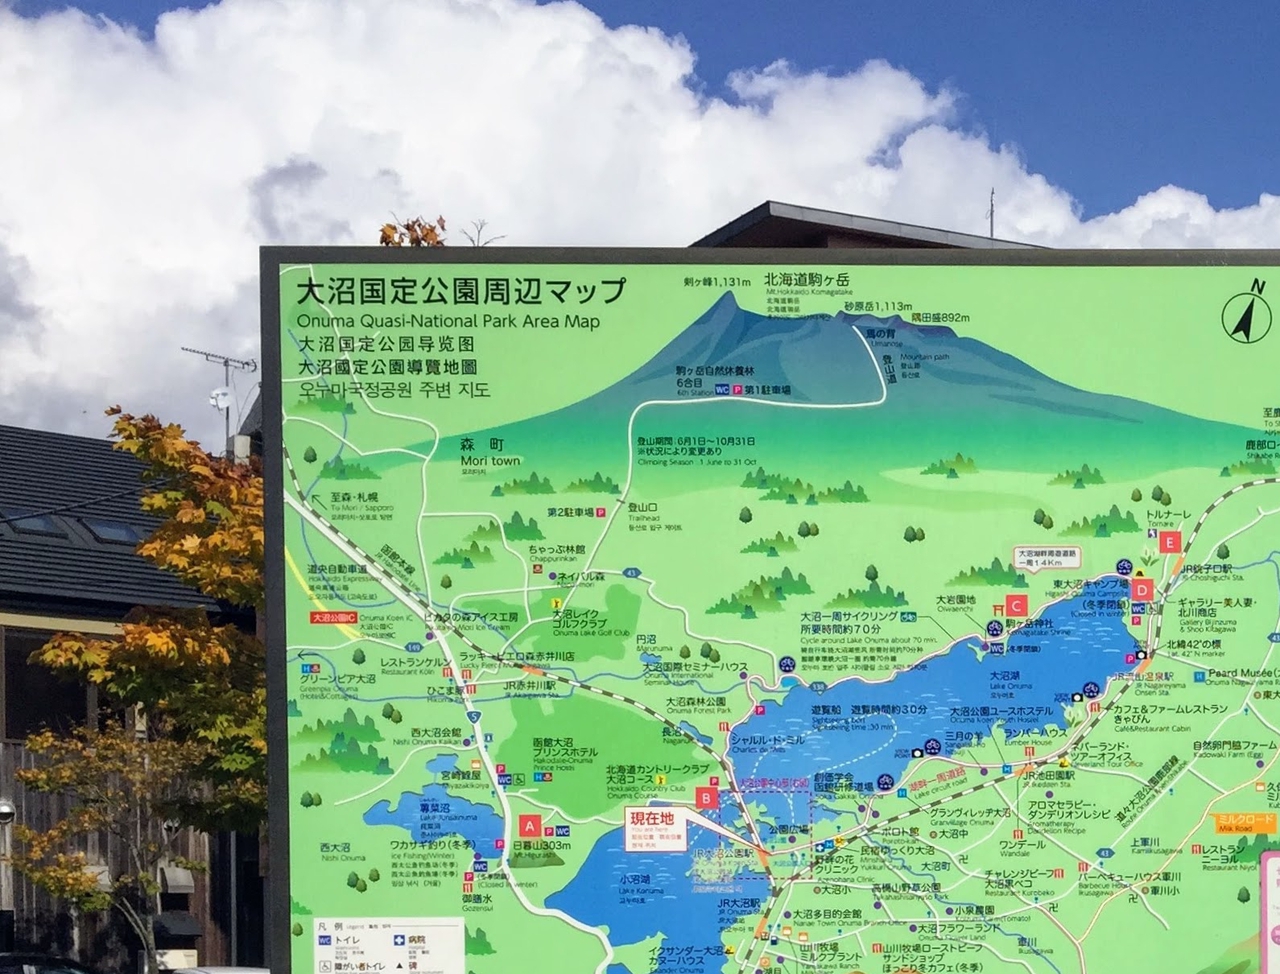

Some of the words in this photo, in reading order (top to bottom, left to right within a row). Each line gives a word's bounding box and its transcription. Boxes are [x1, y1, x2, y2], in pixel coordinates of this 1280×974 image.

[764, 272, 850, 287] 北海道駒ヶ岳
[297, 276, 626, 306] 大沼国定公園周辺マップ
[1251, 278, 1266, 295] N
[297, 313, 355, 329] Onuma
[359, 313, 479, 330] Quasi-National
[483, 313, 517, 329] Park
[522, 313, 560, 329] Area
[565, 314, 601, 331] Map
[299, 336, 475, 352] 大沼国定公园导览图
[420, 381, 454, 399] 주변
[460, 381, 491, 398] 지도
[460, 455, 487, 467] Mori
[491, 456, 521, 467] town
[548, 507, 594, 517] 第2駐車場
[628, 503, 657, 512] 登山口
[1167, 537, 1173, 548] E
[1137, 585, 1147, 595] D
[1012, 601, 1021, 611] C
[990, 672, 1020, 681] 大沼湖
[666, 697, 726, 707] 大沼森林公園
[411, 728, 462, 737] 西大沼会館
[702, 793, 711, 803] B
[631, 812, 674, 825] 現在地
[525, 821, 534, 831] A
[320, 843, 350, 852] 西大沼
[335, 936, 360, 945] トイレ
